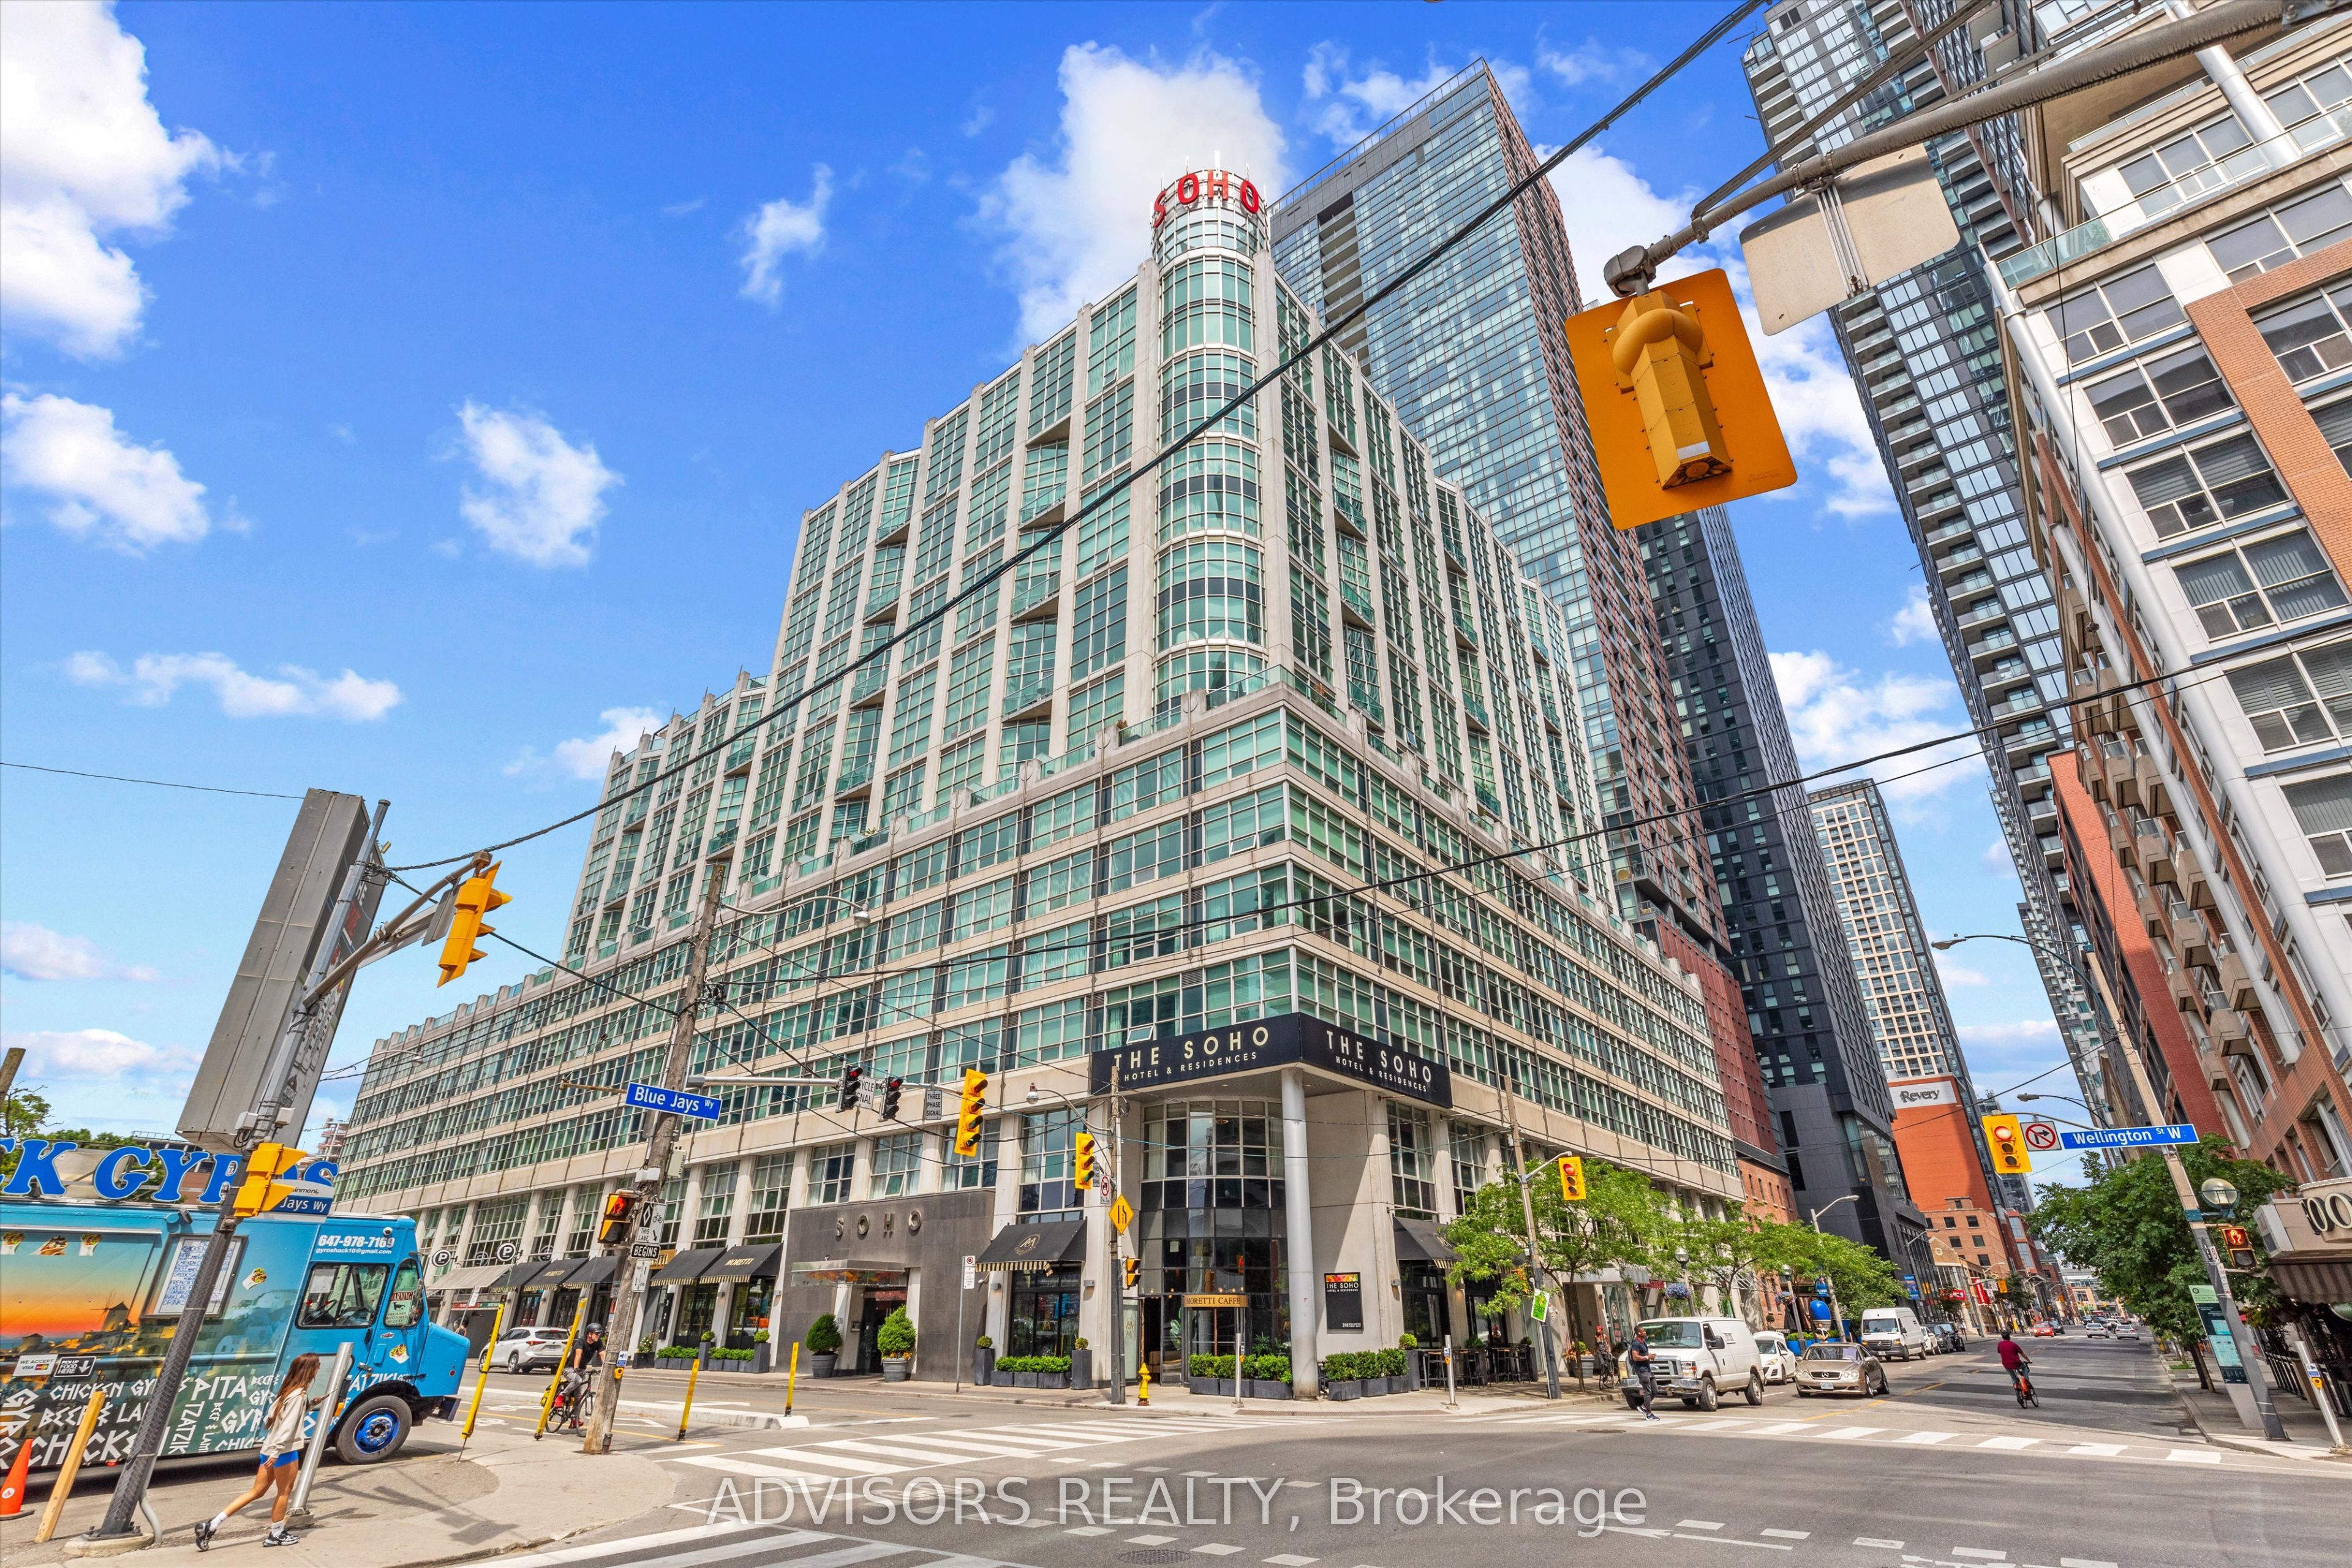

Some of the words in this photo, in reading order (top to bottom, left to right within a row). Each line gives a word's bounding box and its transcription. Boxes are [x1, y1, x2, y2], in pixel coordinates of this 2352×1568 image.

[1153, 170, 1259, 228] SOHO
[1114, 1047, 1159, 1071] THE
[1184, 1027, 1268, 1059] SOHO
[1327, 1030, 1364, 1060] THE
[1381, 1050, 1431, 1083] SOHO
[1125, 1069, 1158, 1081] HOTEL
[1181, 1052, 1257, 1071] RESIDENCES
[1336, 1056, 1363, 1071] HOTEL
[1379, 1071, 1427, 1092] RESIDENCES
[635, 1087, 666, 1105] Blue
[670, 1093, 699, 1113] Jays
[704, 1099, 714, 1109] Wy
[857, 1094, 871, 1104] GNAL
[1899, 1090, 1940, 1102] Revery
[2073, 1131, 2152, 1145] Wellington
[2166, 1126, 2181, 1139] W
[279, 1197, 309, 1212] Jays
[313, 1200, 327, 1212] Wy
[835, 1210, 922, 1237] SOHO
[318, 1235, 395, 1248] 647-978-7169
[633, 1246, 658, 1259] BEGINS
[191, 1376, 247, 1401] PITA
